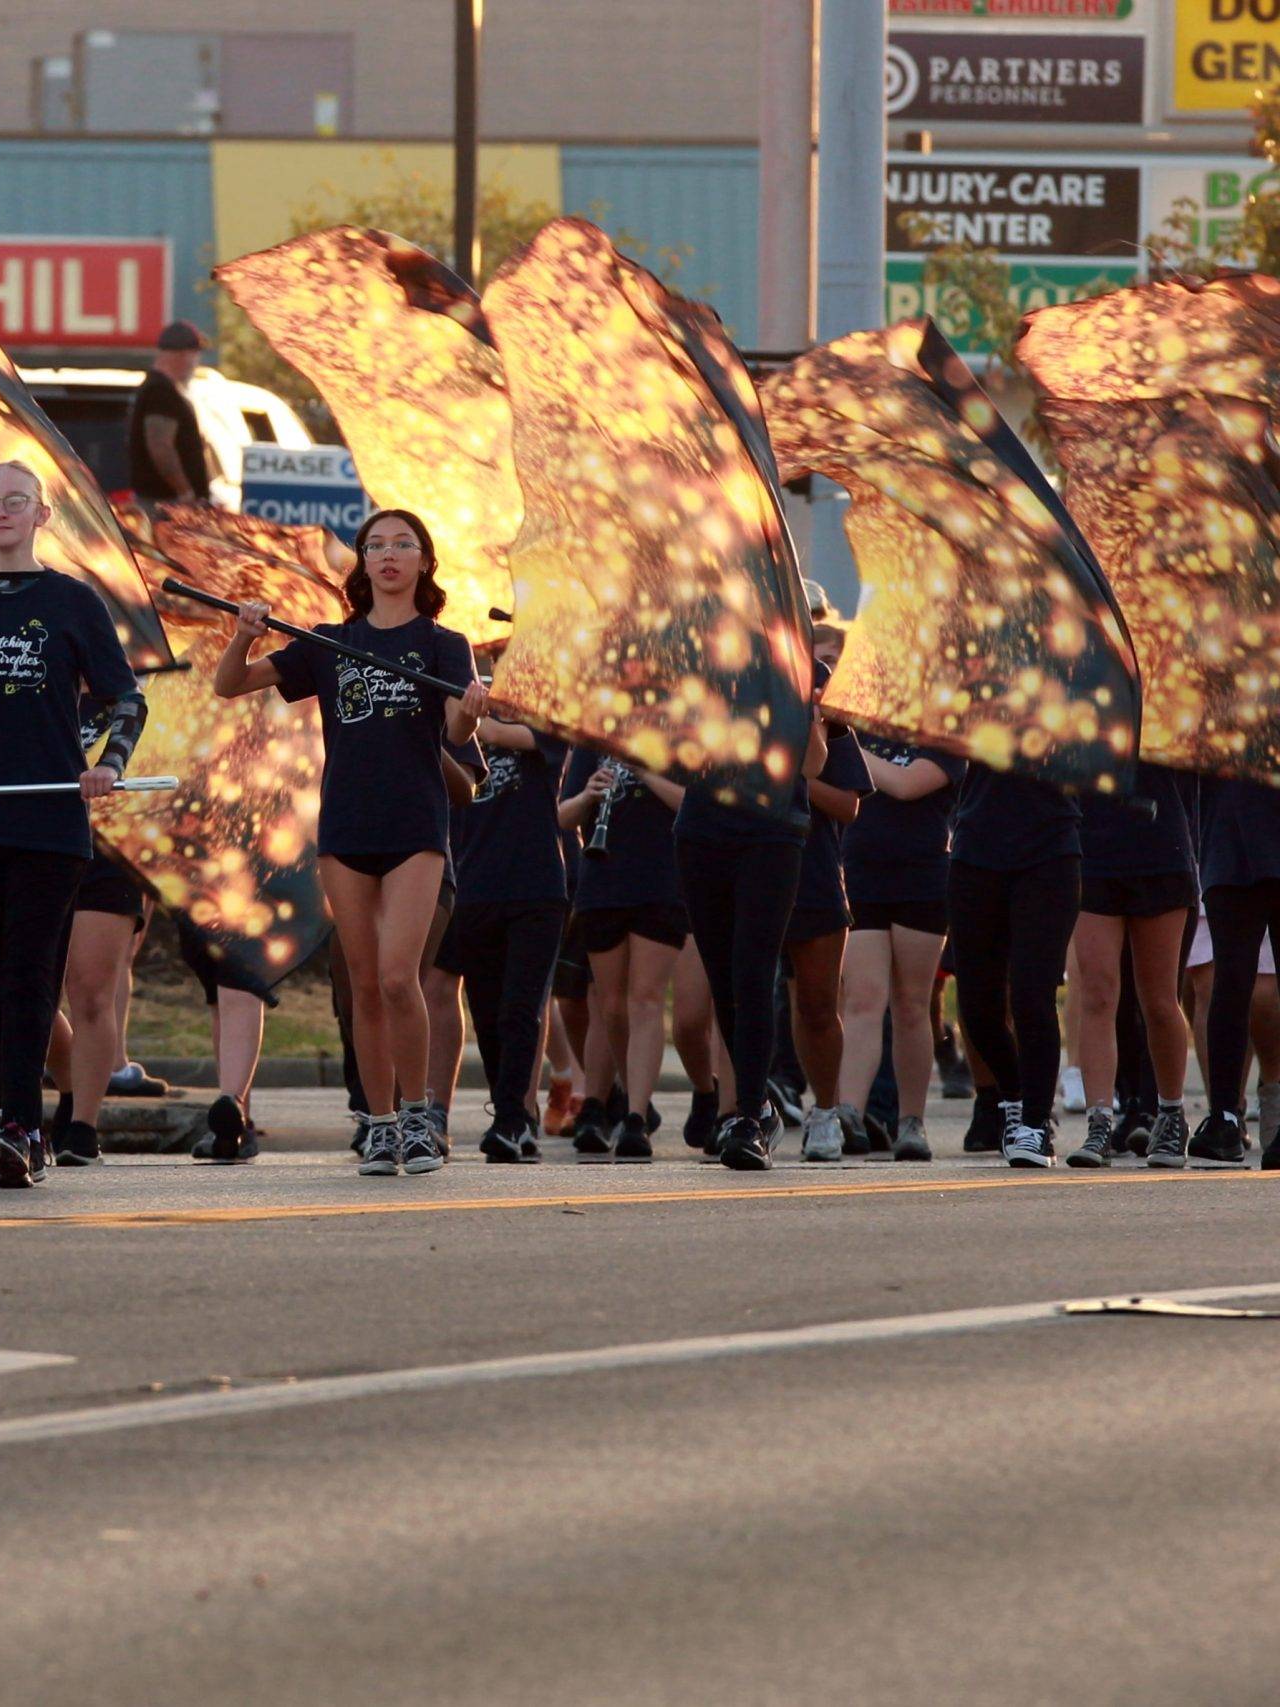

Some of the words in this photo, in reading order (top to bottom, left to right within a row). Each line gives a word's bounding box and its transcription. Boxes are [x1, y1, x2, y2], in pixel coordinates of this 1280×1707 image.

[929, 56, 1122, 87] PARTNERS
[929, 84, 1065, 106] PERSONNEL
[887, 171, 1106, 207] NJURY-CARE
[243, 453, 334, 477] CHASE
[243, 501, 364, 530] COMING
